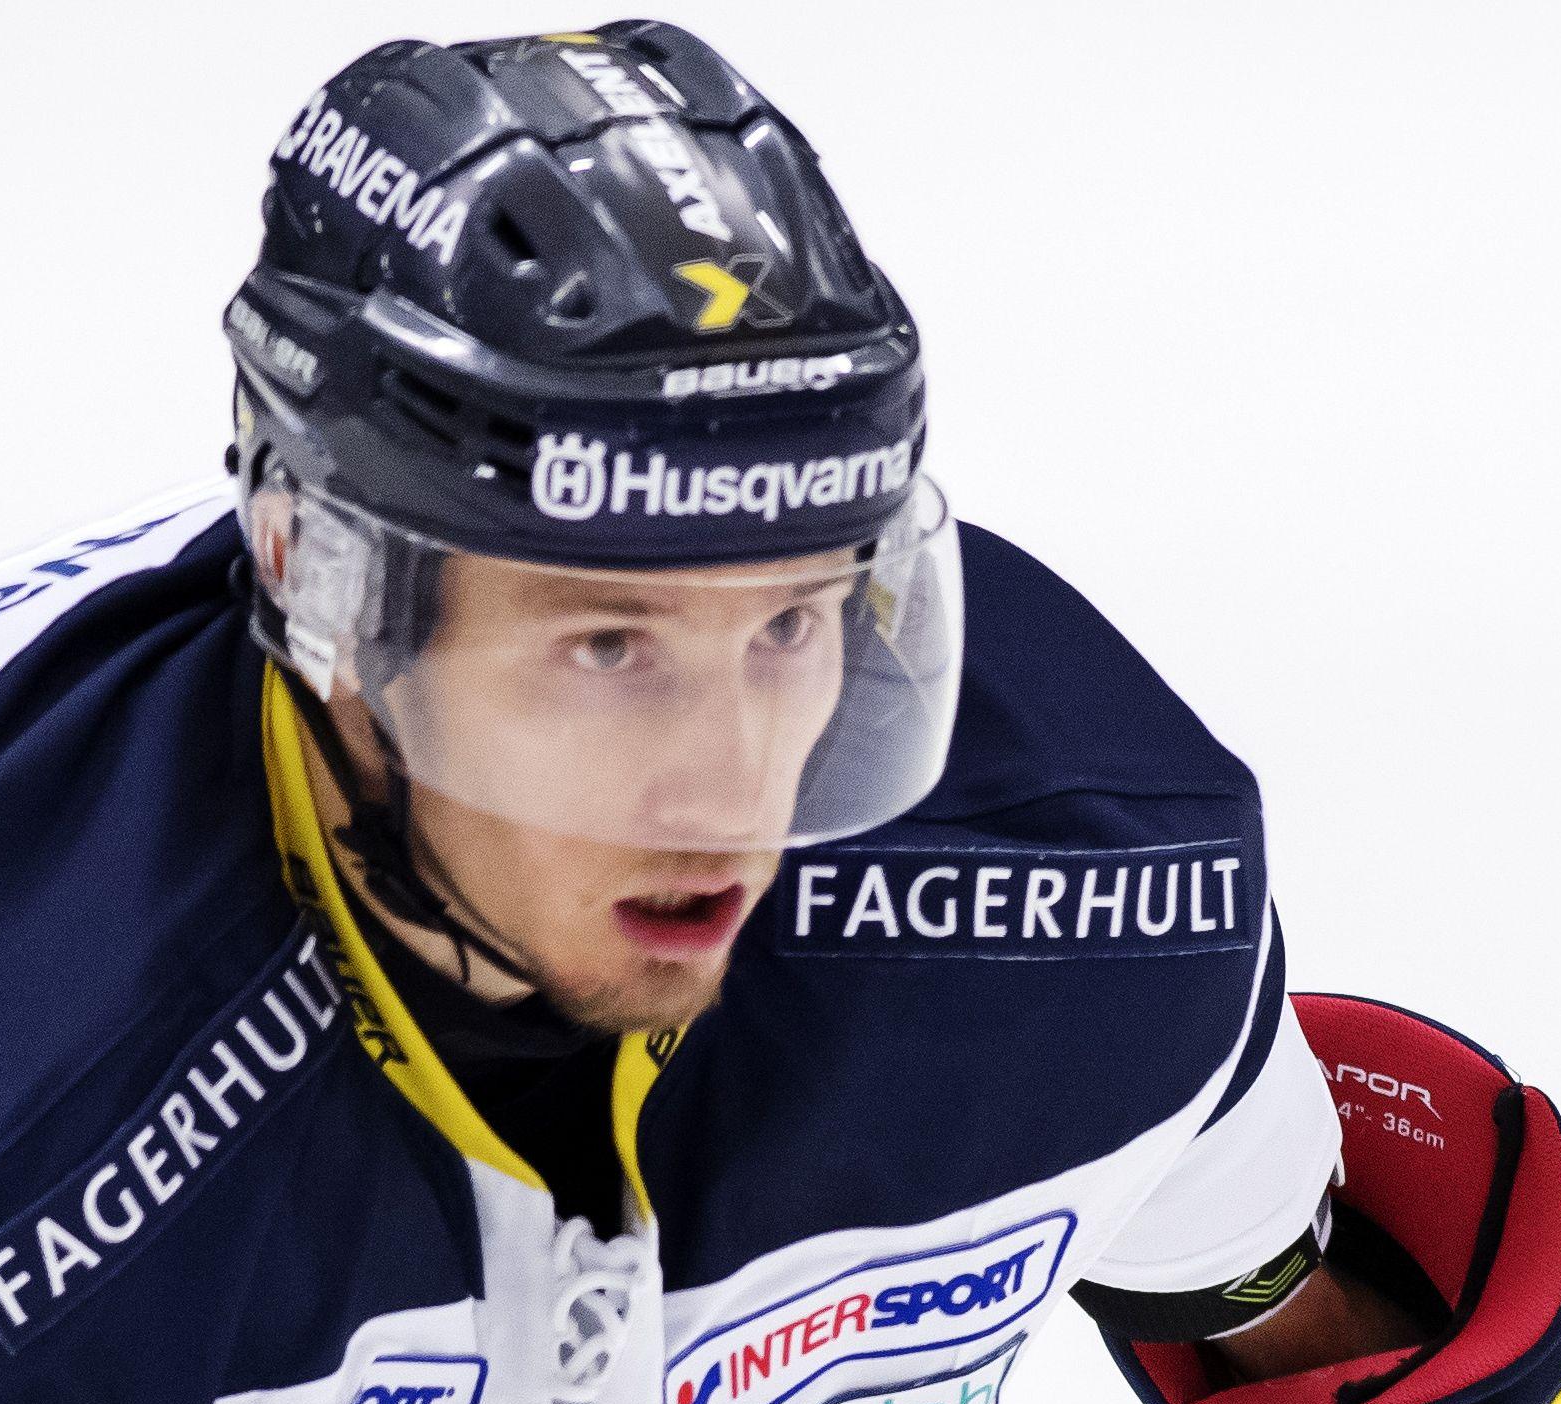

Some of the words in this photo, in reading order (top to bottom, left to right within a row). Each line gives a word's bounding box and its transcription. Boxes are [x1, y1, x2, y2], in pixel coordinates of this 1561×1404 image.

[299, 107, 469, 266] RAVEMA
[609, 439, 913, 523] Husqvarna
[793, 857, 1241, 939] FAGERHULT
[729, 1240, 1045, 1400] INTERSPORT
